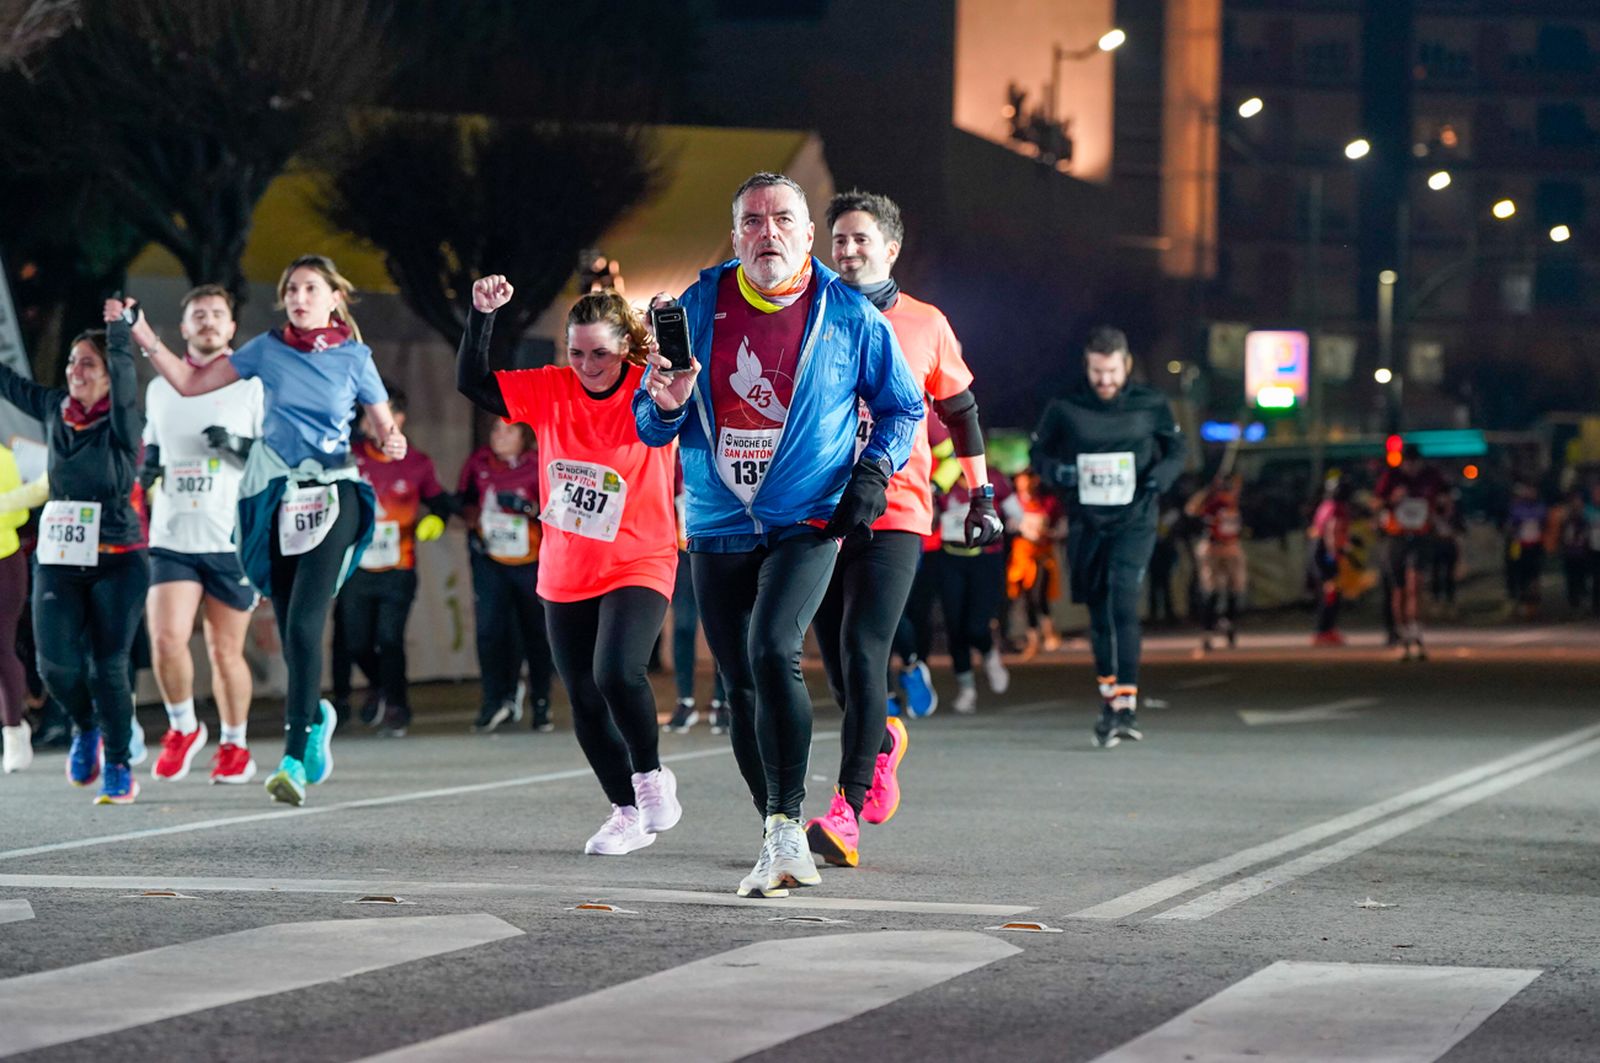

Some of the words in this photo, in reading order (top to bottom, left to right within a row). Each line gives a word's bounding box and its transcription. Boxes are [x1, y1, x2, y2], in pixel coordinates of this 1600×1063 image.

[747, 384, 772, 408] 43
[856, 420, 874, 442] 4
[733, 439, 760, 448] NOCHE
[761, 439, 773, 448] DE
[724, 448, 741, 459] SAN
[741, 447, 773, 459] ANTÓN
[557, 472, 573, 481] SAN
[565, 466, 588, 476] NOCHE
[588, 470, 597, 479] DE
[176, 476, 213, 493] 3027
[561, 481, 609, 514] 5437
